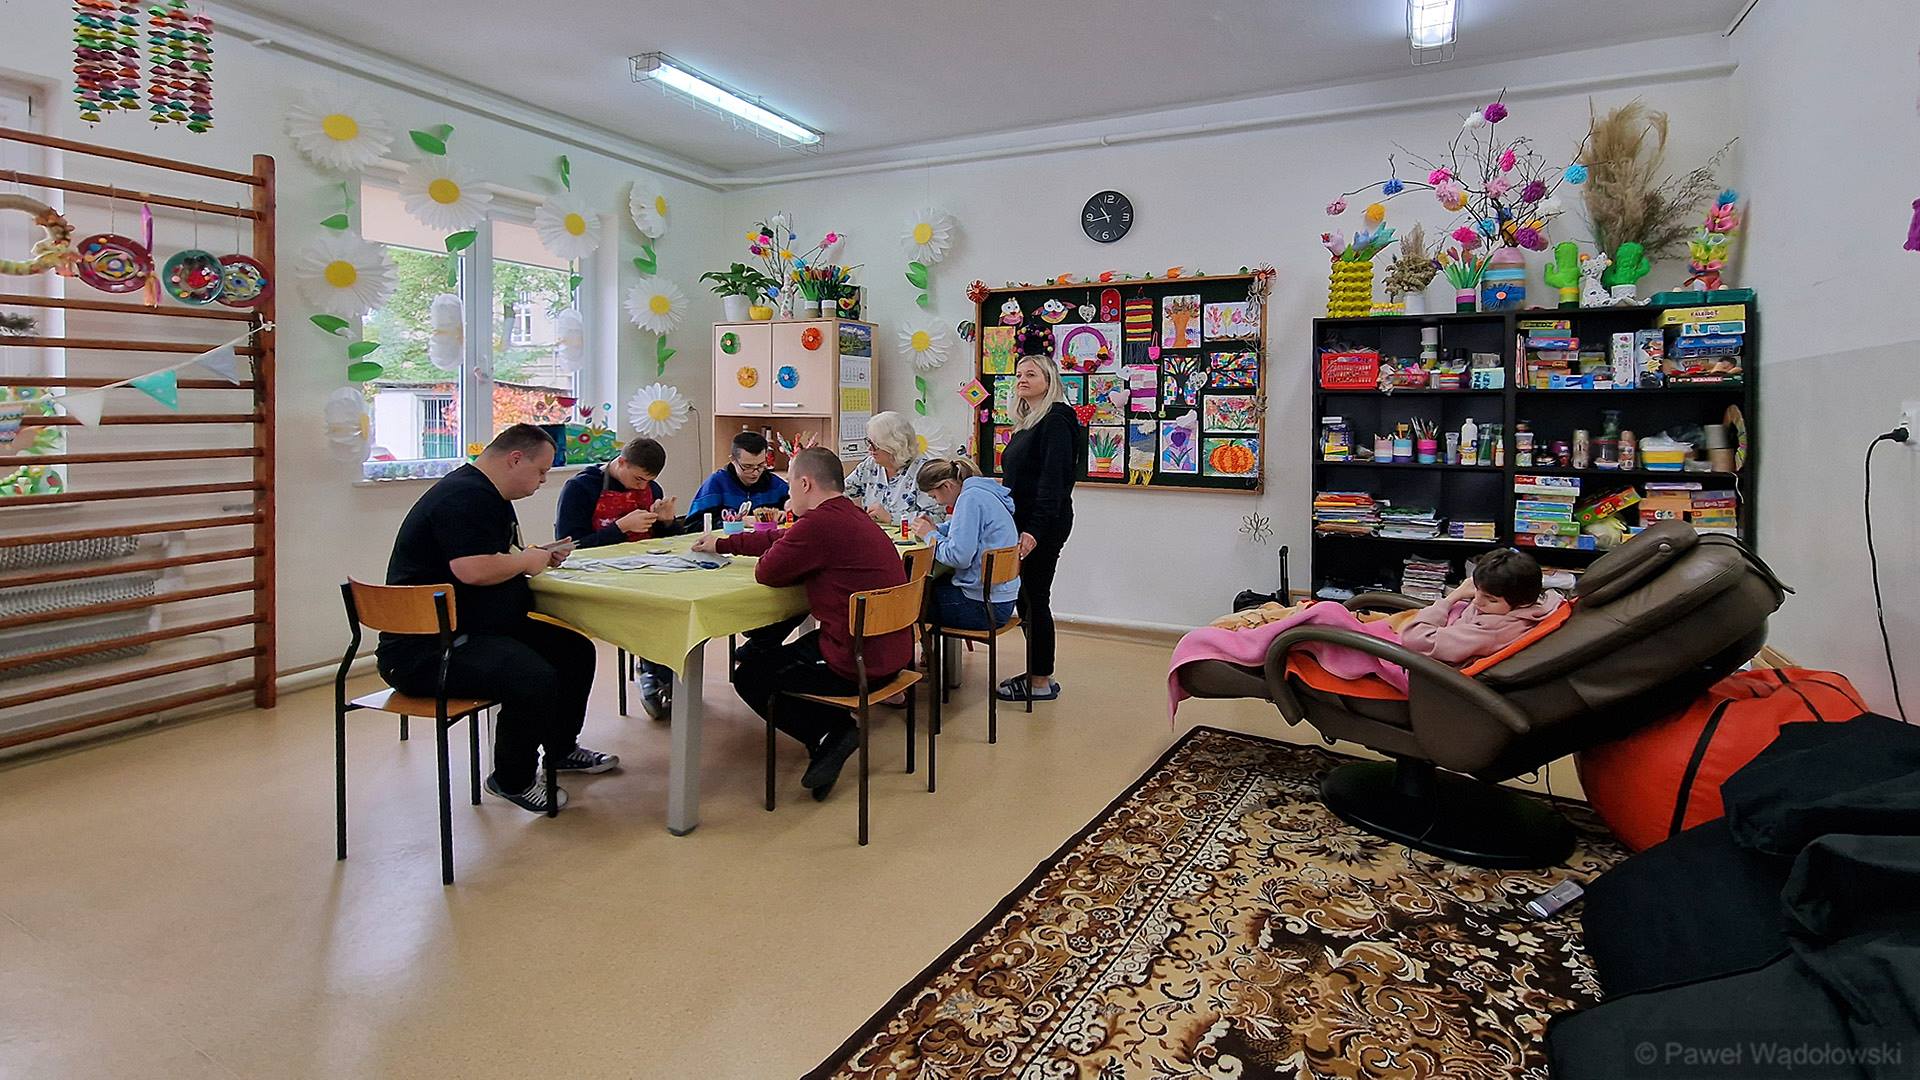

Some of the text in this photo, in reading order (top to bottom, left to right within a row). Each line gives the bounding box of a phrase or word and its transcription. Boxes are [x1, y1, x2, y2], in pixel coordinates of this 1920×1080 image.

[1104, 195, 1115, 203] 12
[1086, 213, 1094, 221] 9
[1123, 213, 1130, 221] 3
[1102, 231, 1109, 239] 6
